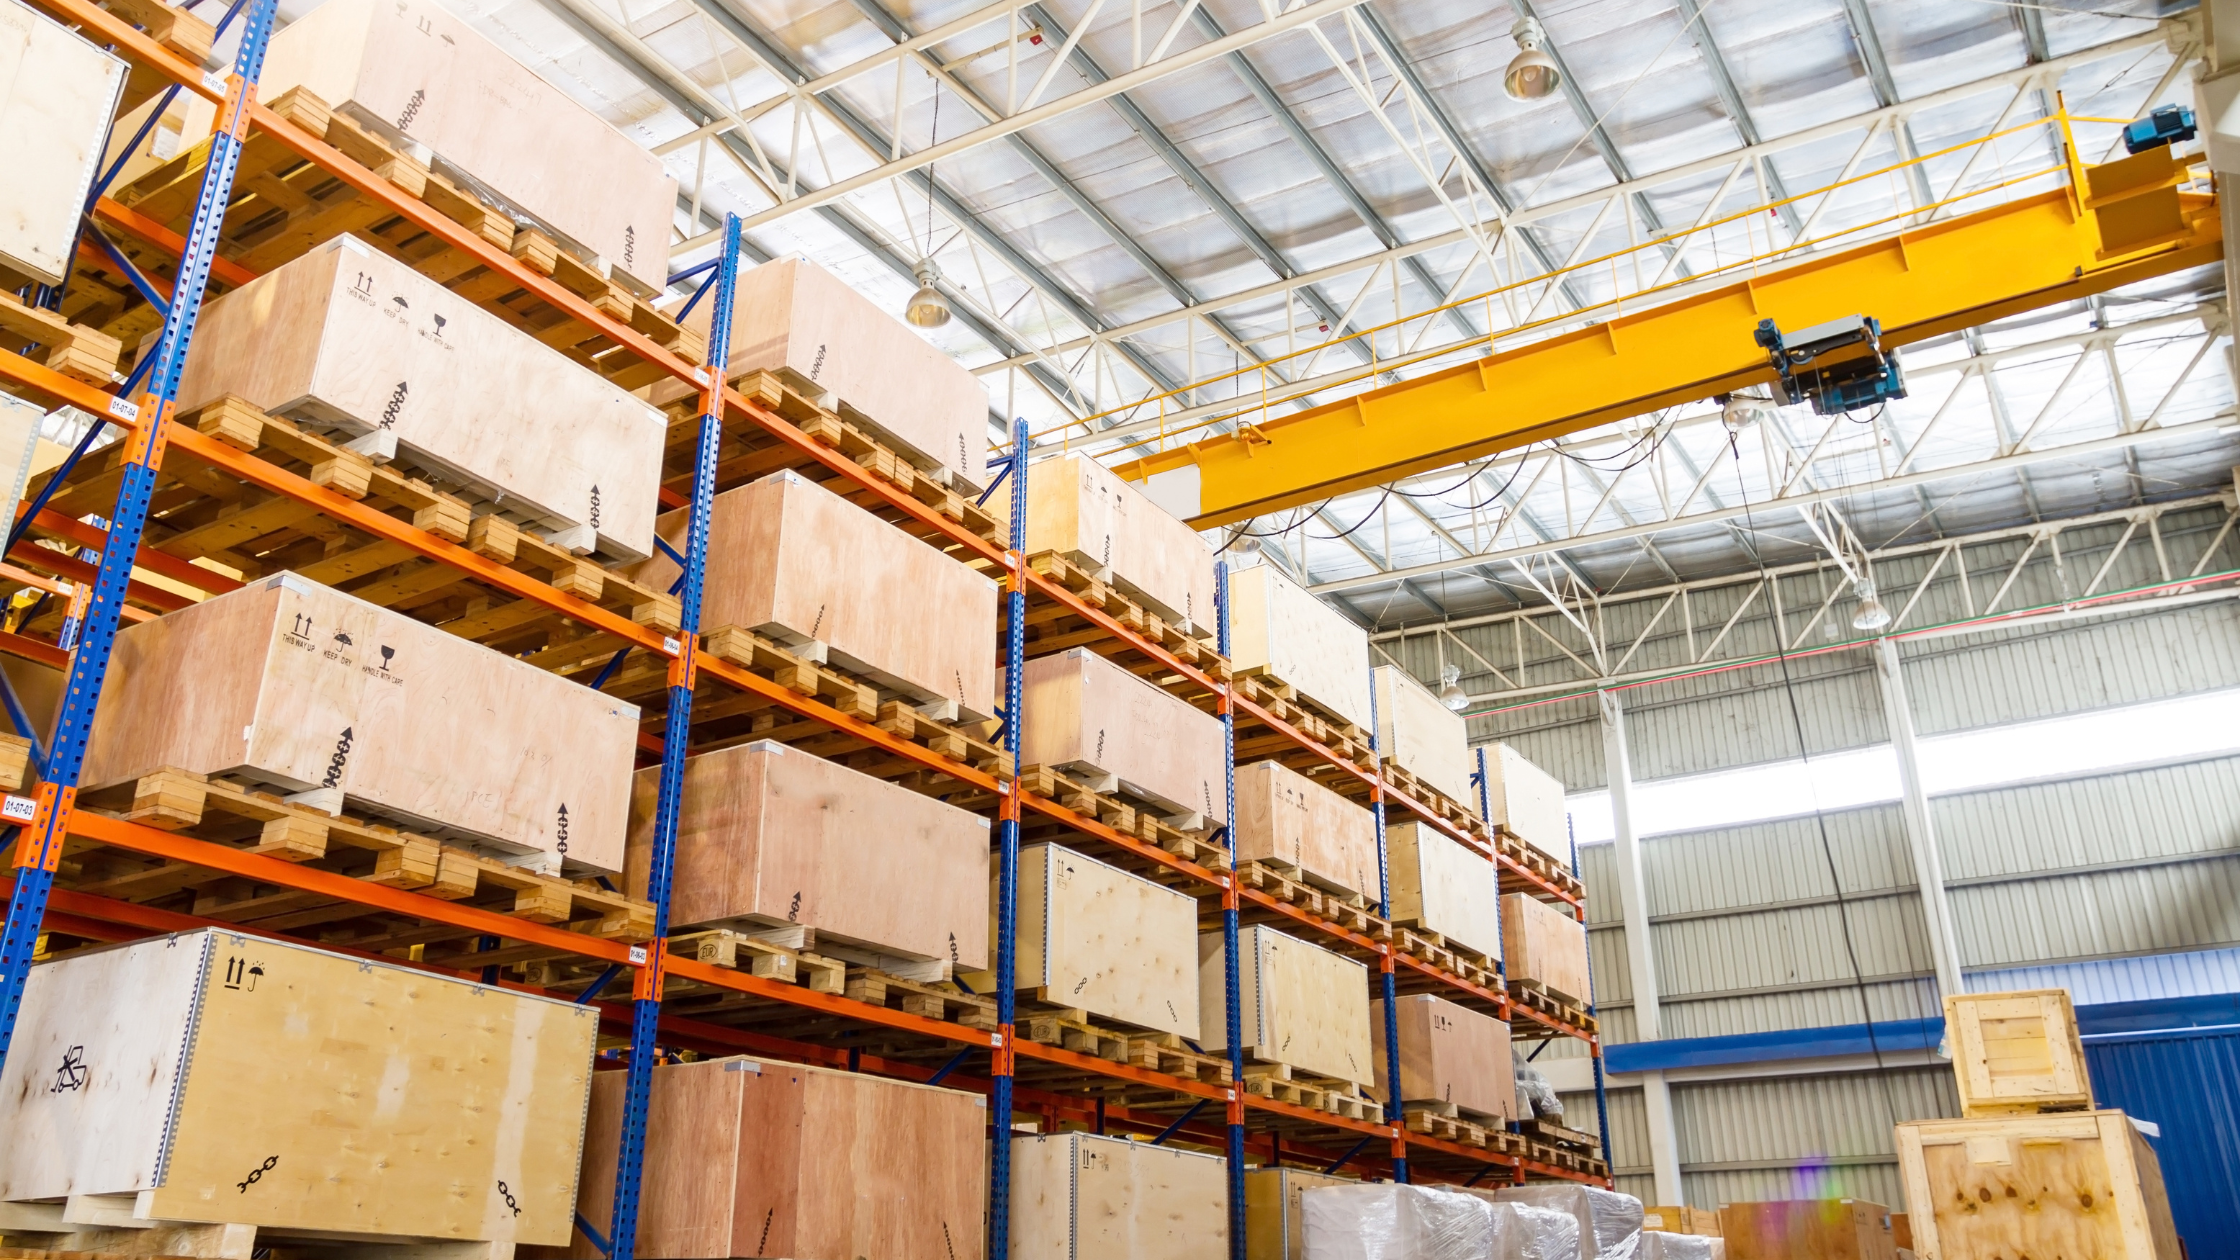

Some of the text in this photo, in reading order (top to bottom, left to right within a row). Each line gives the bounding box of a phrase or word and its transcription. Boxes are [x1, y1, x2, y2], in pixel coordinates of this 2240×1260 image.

[203, 75, 226, 93] 01-07-05
[346, 286, 377, 308] THIS WAY UP
[383, 308, 409, 327] KEEP DRY
[111, 400, 136, 417] 01-07-04
[282, 633, 316, 653] THIS WAY UP
[323, 648, 353, 667] KEEP DRY
[361, 664, 404, 687] HANDLE WITH CARE
[5, 800, 33, 816] 01-07-03
